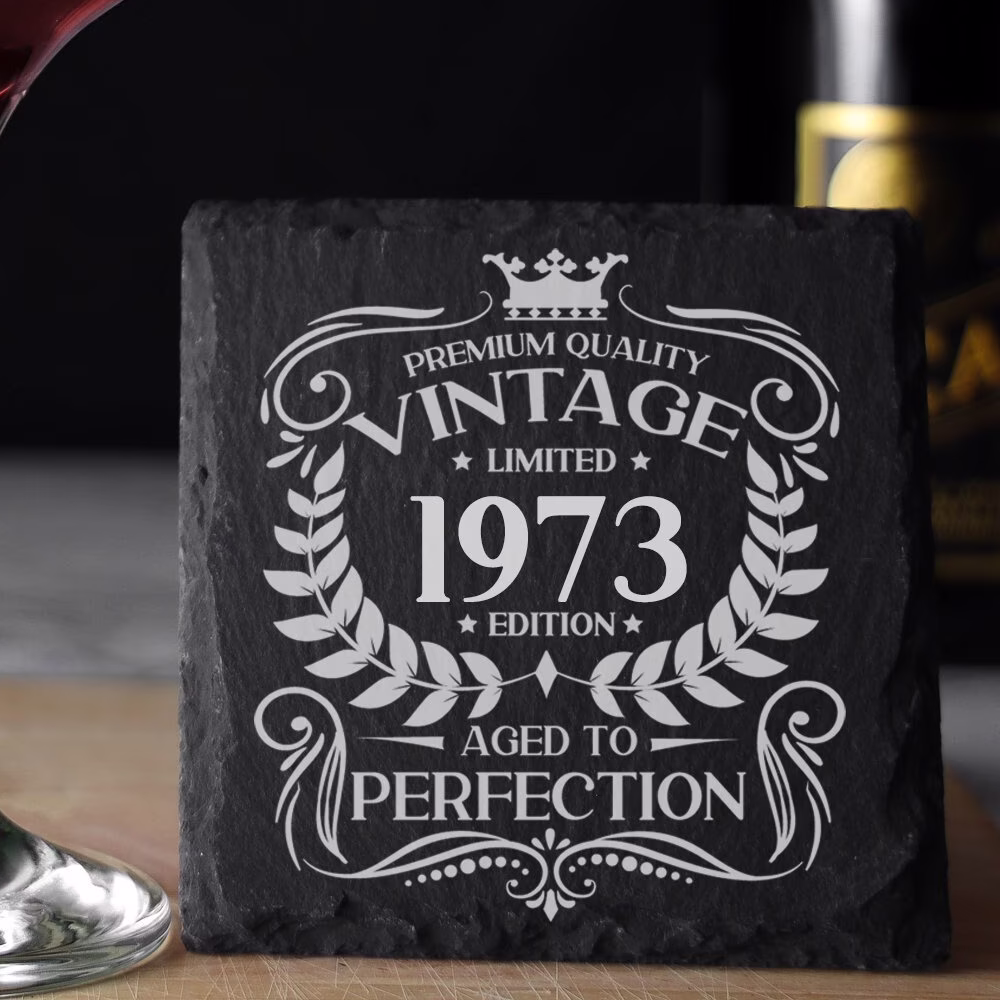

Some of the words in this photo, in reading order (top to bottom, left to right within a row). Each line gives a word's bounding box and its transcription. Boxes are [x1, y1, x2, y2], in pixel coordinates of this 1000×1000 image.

[402, 332, 556, 377] PREMIUM
[566, 331, 711, 376] QUALITY
[342, 367, 748, 459] VINTAGE
[487, 447, 617, 473] LIMITED
[410, 495, 688, 604] 1973
[487, 611, 617, 637] EDITION
[461, 725, 570, 756] AGED
[582, 724, 638, 757] TO
[350, 771, 747, 821] PERFECTION
